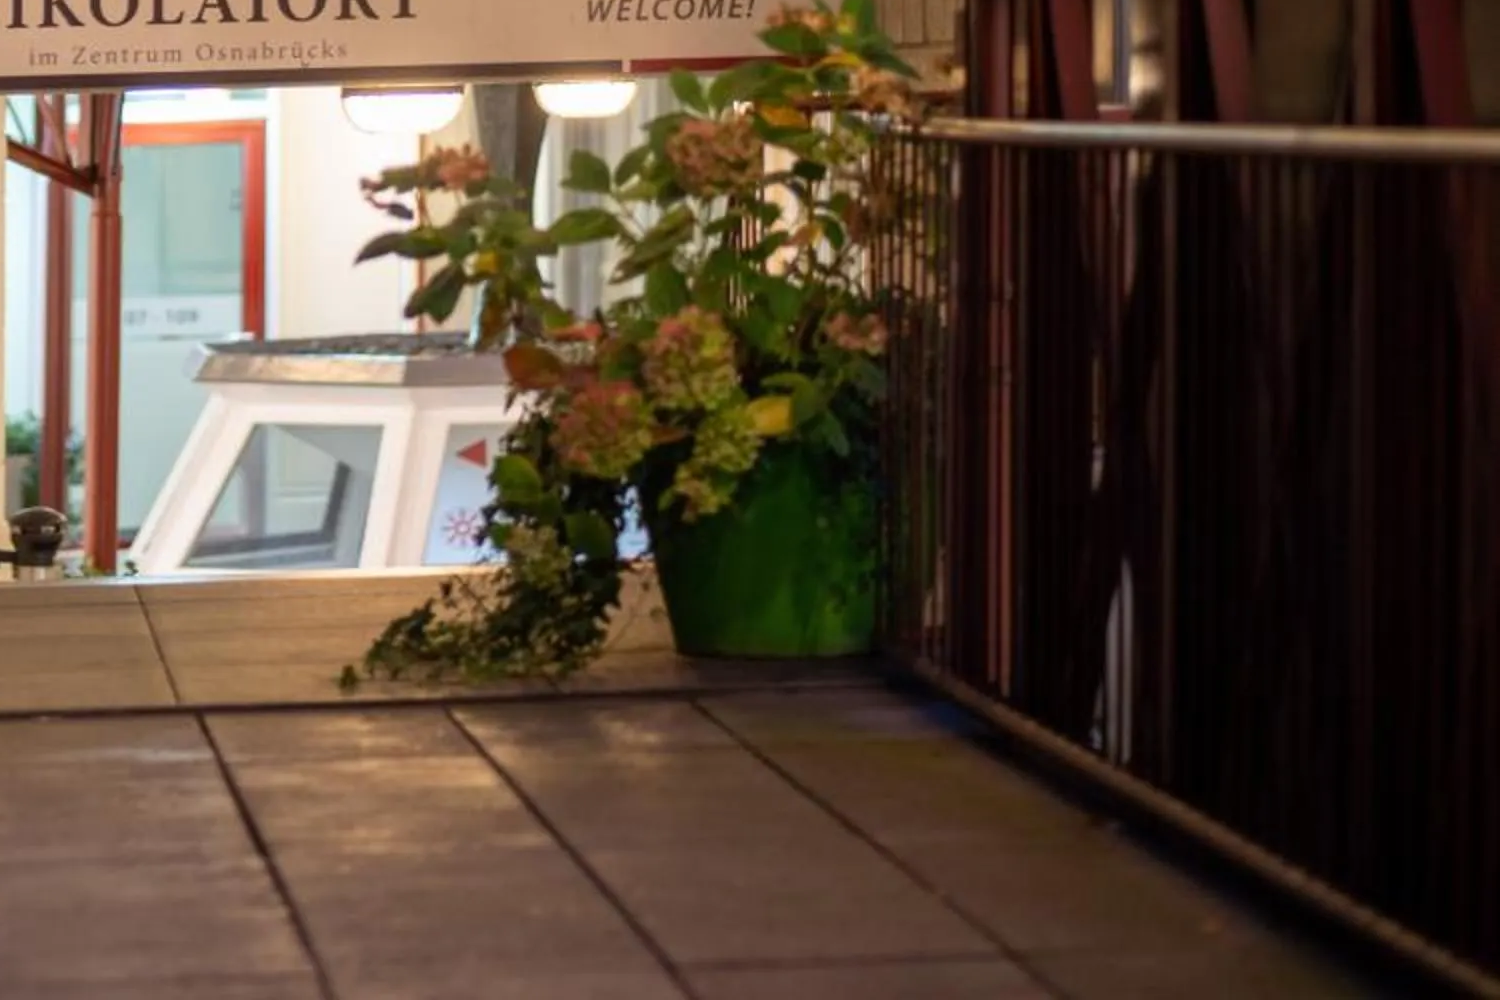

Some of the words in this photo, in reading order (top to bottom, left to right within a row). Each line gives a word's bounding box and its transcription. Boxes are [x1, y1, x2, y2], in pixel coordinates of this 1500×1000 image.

[28, 51, 56, 67] im
[71, 46, 184, 66] Zentrum
[194, 42, 349, 64] Osnabrücks
